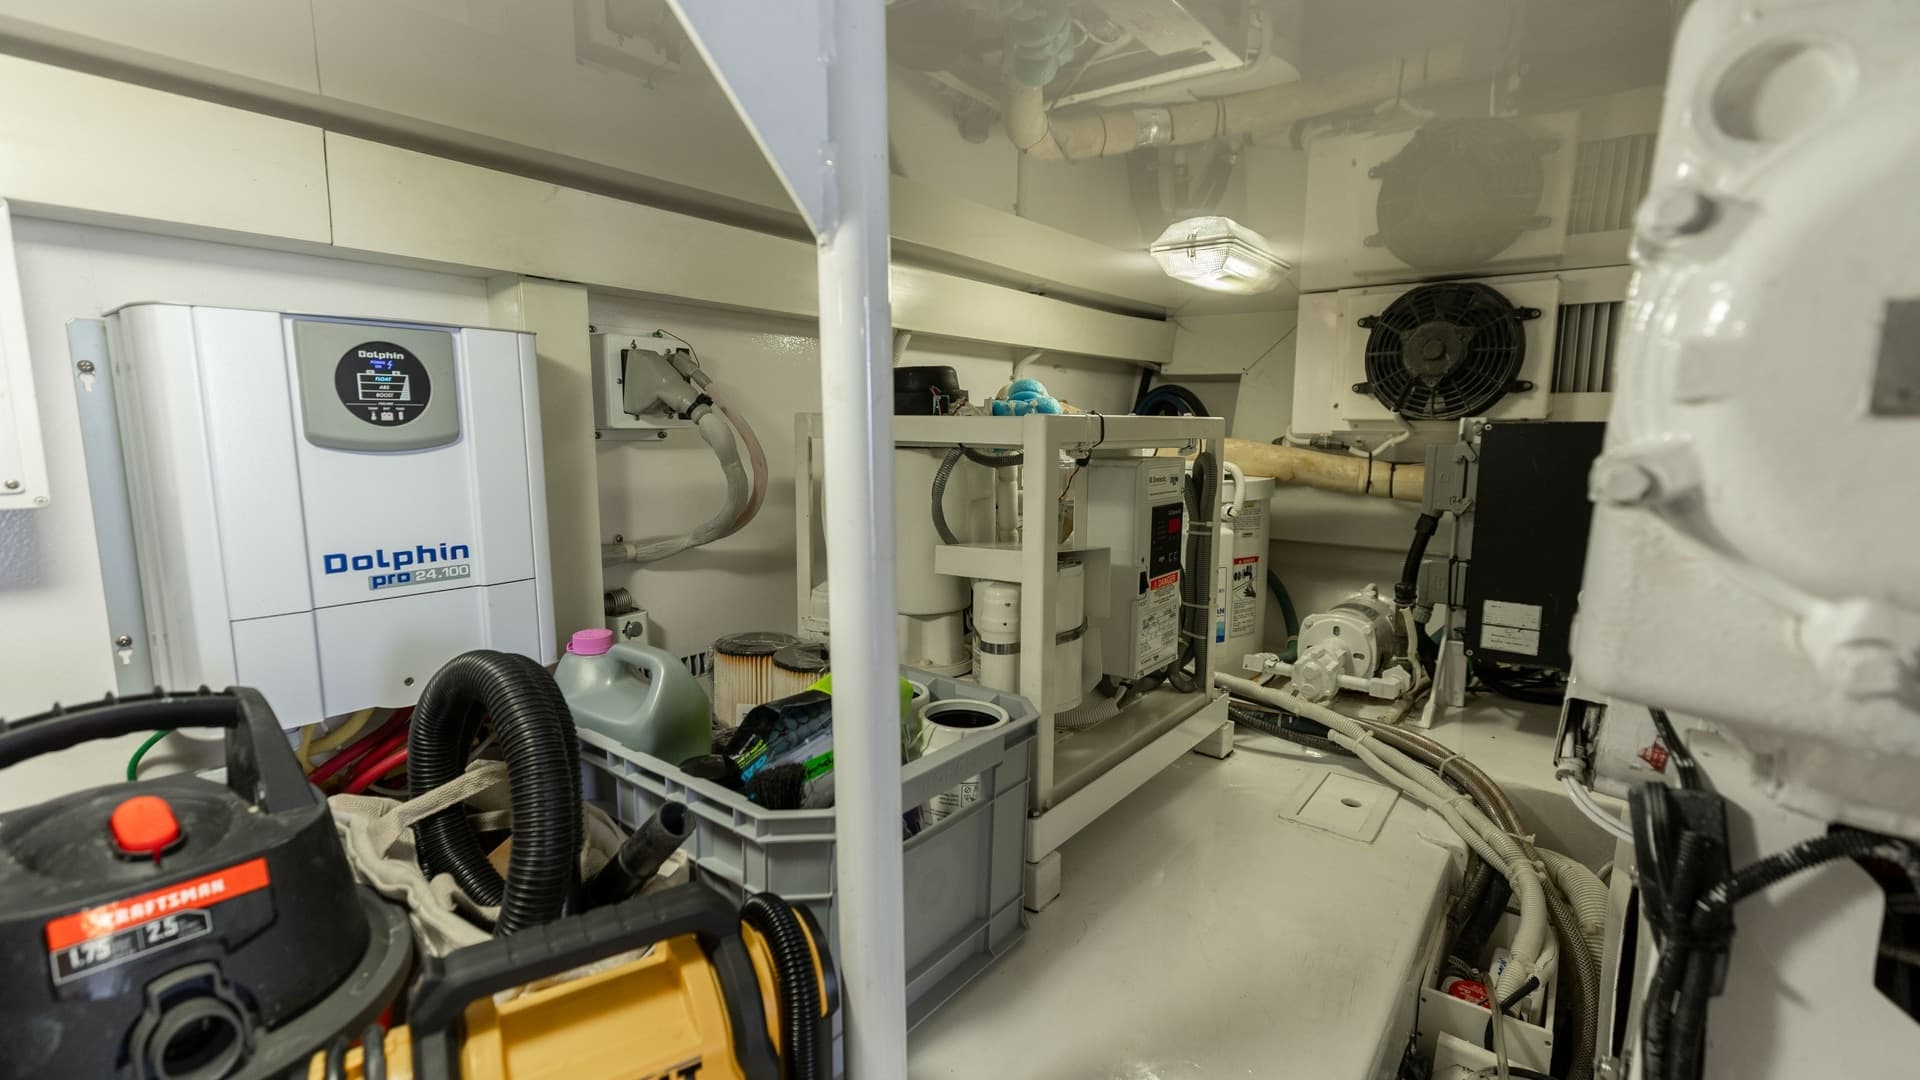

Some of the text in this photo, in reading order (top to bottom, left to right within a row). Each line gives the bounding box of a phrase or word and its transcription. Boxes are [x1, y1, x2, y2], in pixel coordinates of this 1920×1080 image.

[358, 350, 404, 360] Dolphin
[323, 543, 469, 575] Dolphin
[372, 565, 469, 589] pro 24.100
[1157, 572, 1178, 588] DANGER
[97, 878, 225, 928] CRAFTSMAN
[146, 915, 179, 943] 2.5
[68, 934, 112, 969] 1.75
